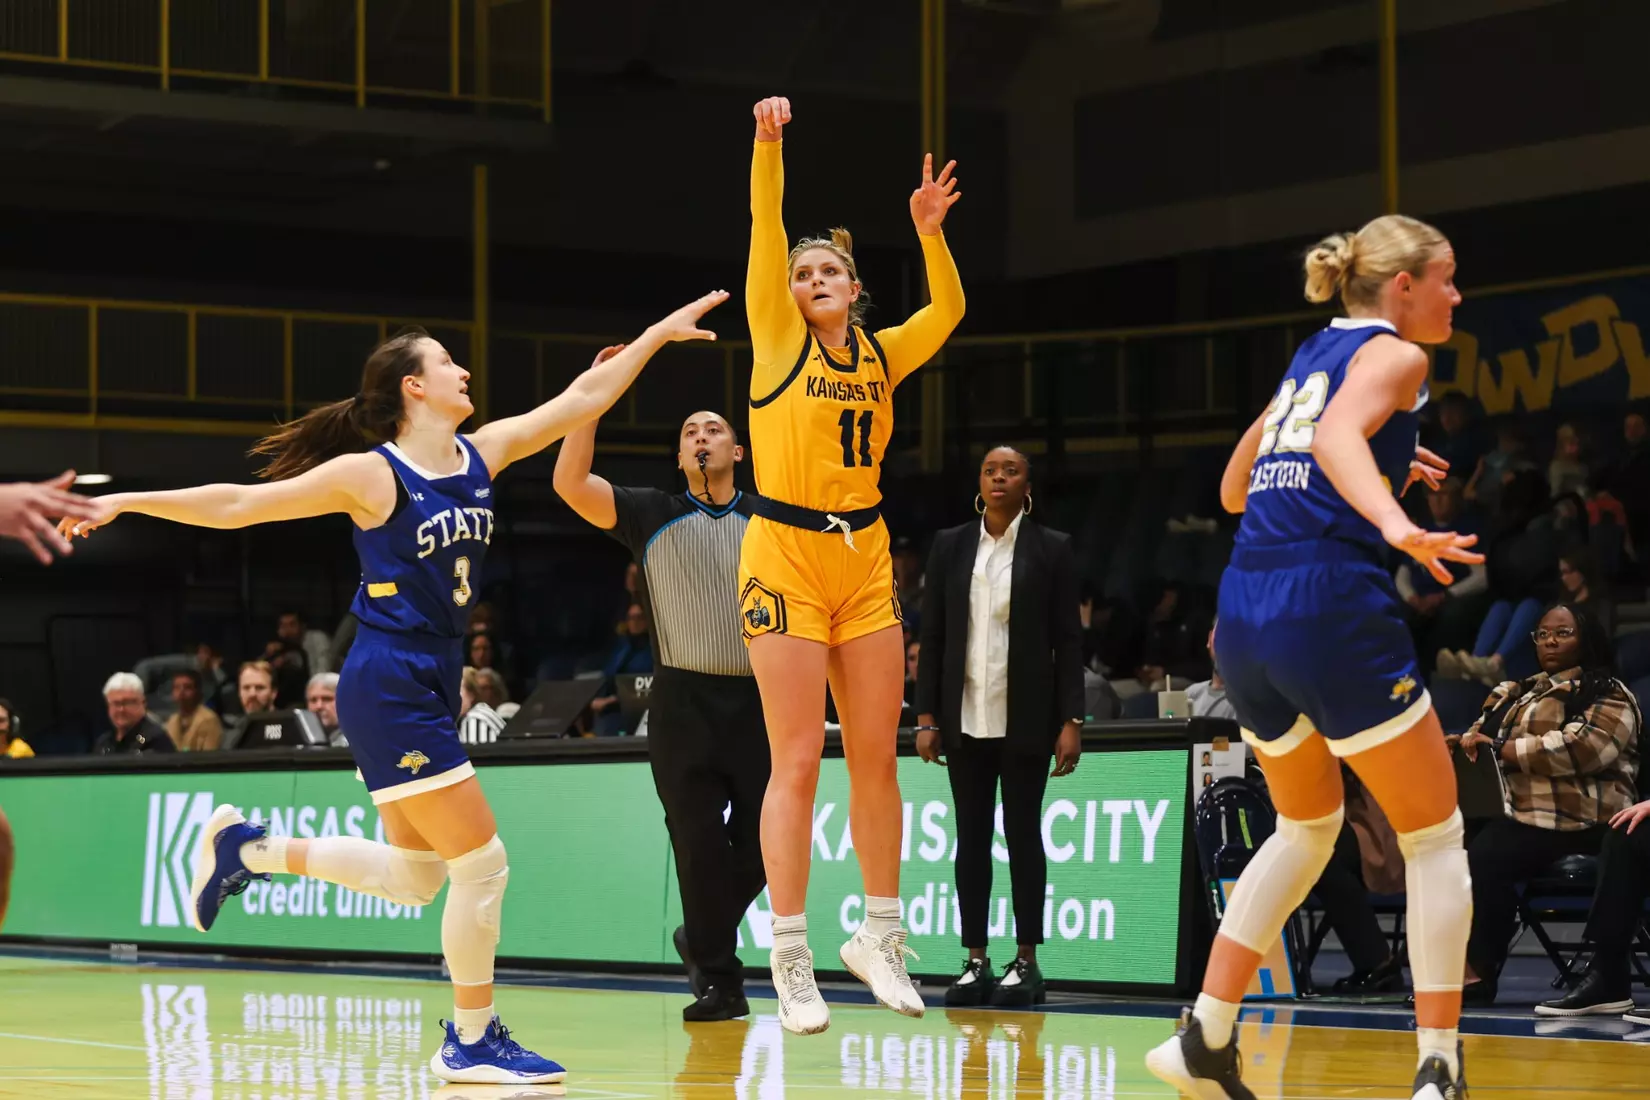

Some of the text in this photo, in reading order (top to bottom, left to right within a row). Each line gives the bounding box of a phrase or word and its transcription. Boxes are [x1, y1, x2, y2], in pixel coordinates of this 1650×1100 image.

[806, 376, 866, 402] KANSAS
[1255, 371, 1329, 459] 22
[838, 409, 874, 468] 11
[452, 556, 473, 607] 3
[231, 805, 366, 839] NSAS
[1041, 799, 1170, 863] CITY
[242, 874, 328, 918] credit
[840, 882, 962, 937] cdit
[988, 884, 1115, 941] uion
